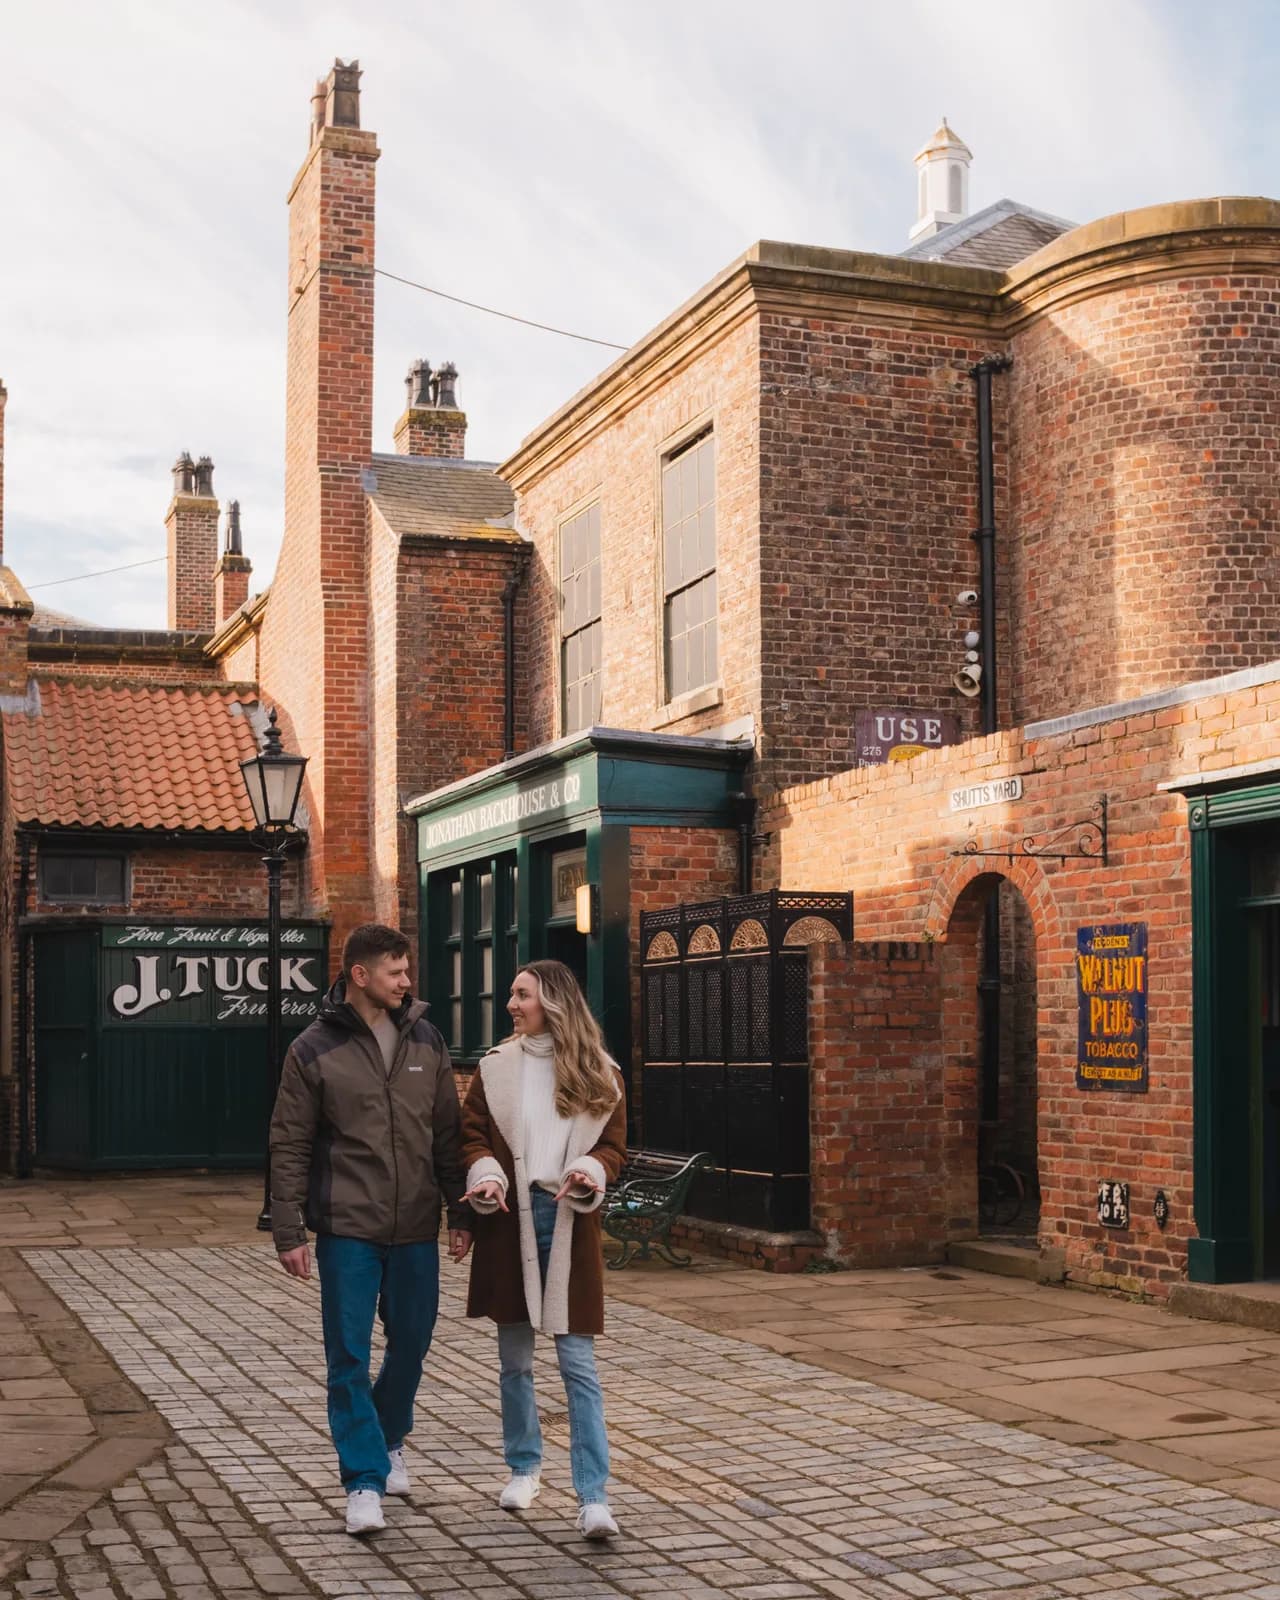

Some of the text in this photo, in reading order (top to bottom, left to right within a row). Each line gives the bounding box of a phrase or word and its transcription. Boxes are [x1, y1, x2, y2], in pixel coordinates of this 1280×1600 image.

[875, 716, 942, 743] USE
[862, 746, 882, 756] 275
[952, 779, 1018, 809] SHUTTS YARD
[426, 811, 476, 848] JONATHAN
[480, 788, 546, 829] BACKHOUSE
[550, 782, 560, 807] &
[117, 926, 307, 947] Fine Fruit & Vegebles
[113, 955, 318, 1015] J. TUCK
[1078, 955, 1145, 993] WALNUT
[216, 994, 318, 1020] Fruerer
[1089, 996, 1134, 1036] PLUG
[1085, 1041, 1138, 1058] TOBACCO
